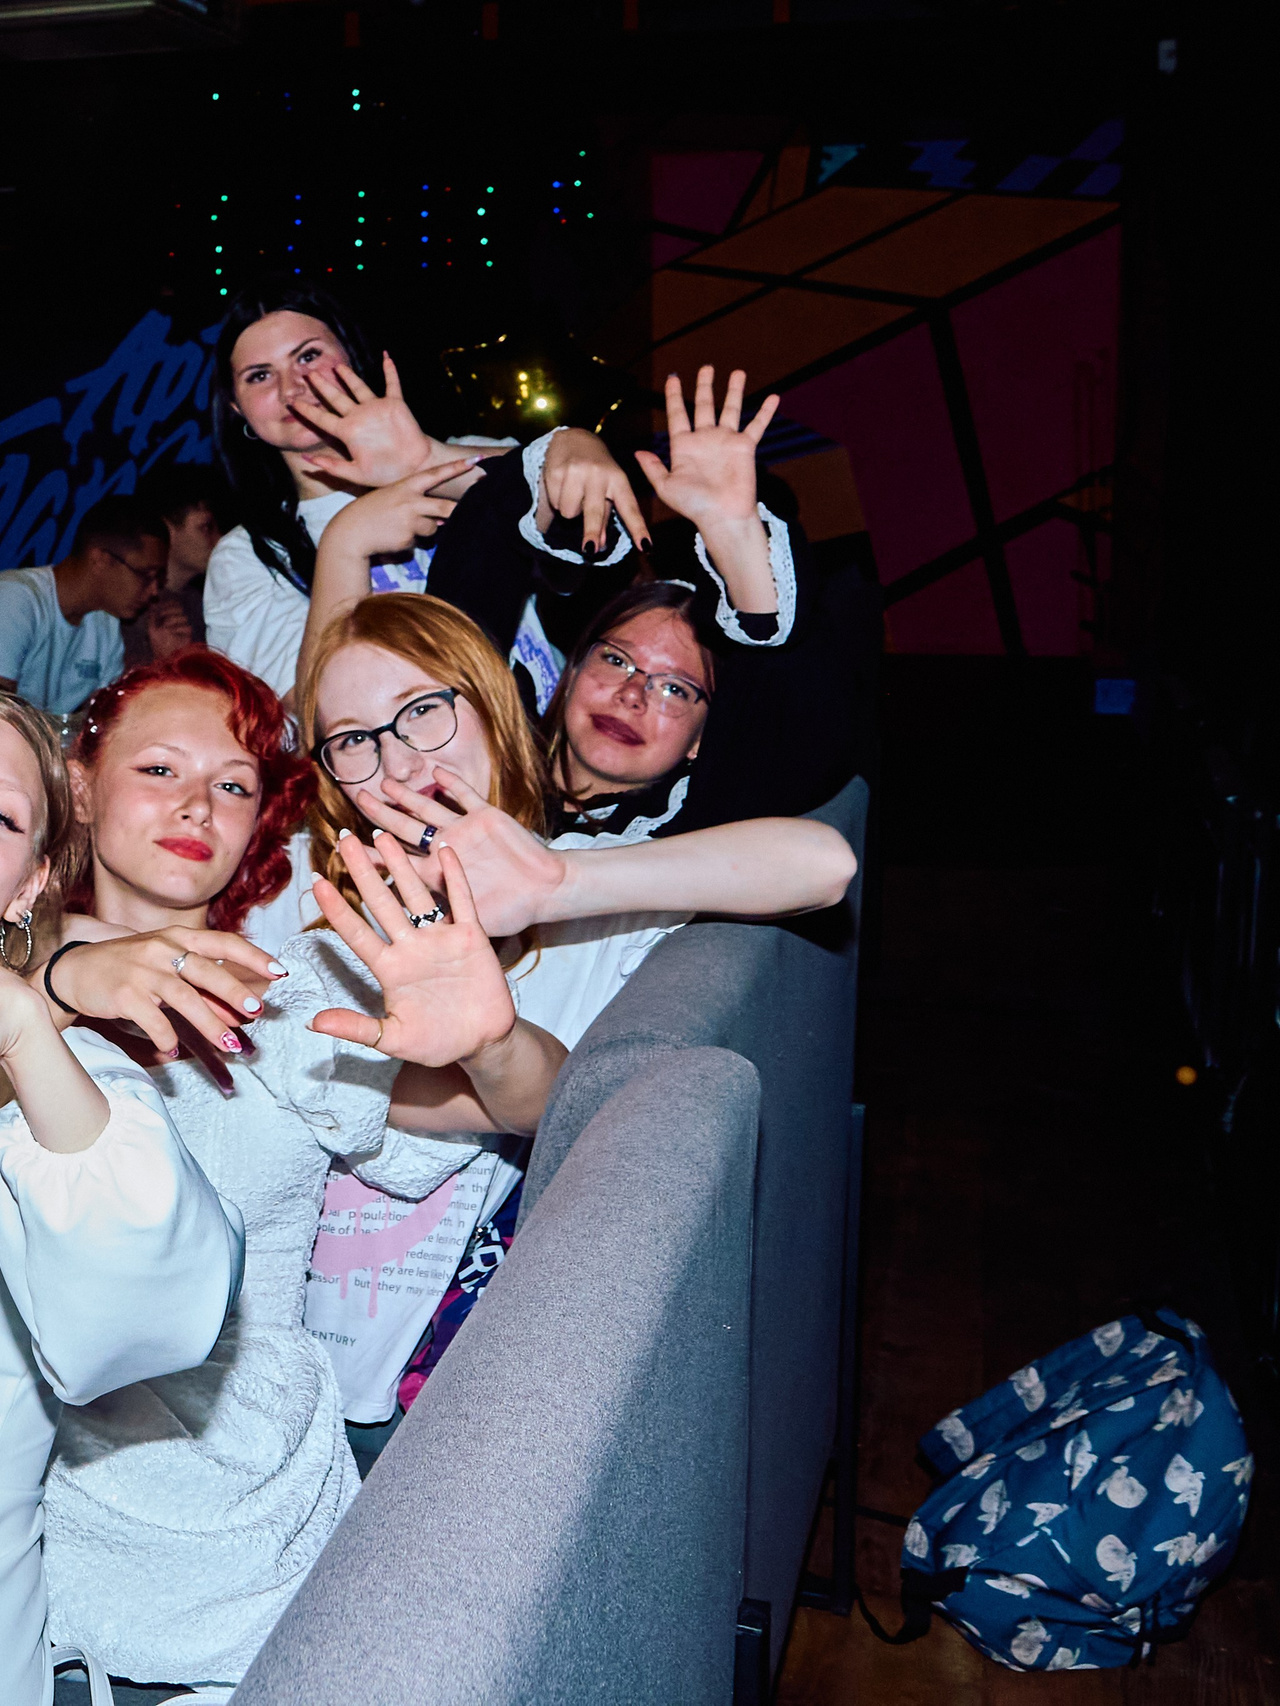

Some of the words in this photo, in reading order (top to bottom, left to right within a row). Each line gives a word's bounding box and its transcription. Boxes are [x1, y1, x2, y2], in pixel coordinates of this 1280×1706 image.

[338, 1225, 351, 1235] of
[397, 1267, 414, 1276] are
[354, 1277, 371, 1289] but
[377, 1281, 401, 1295] they
[406, 1285, 426, 1297] may
